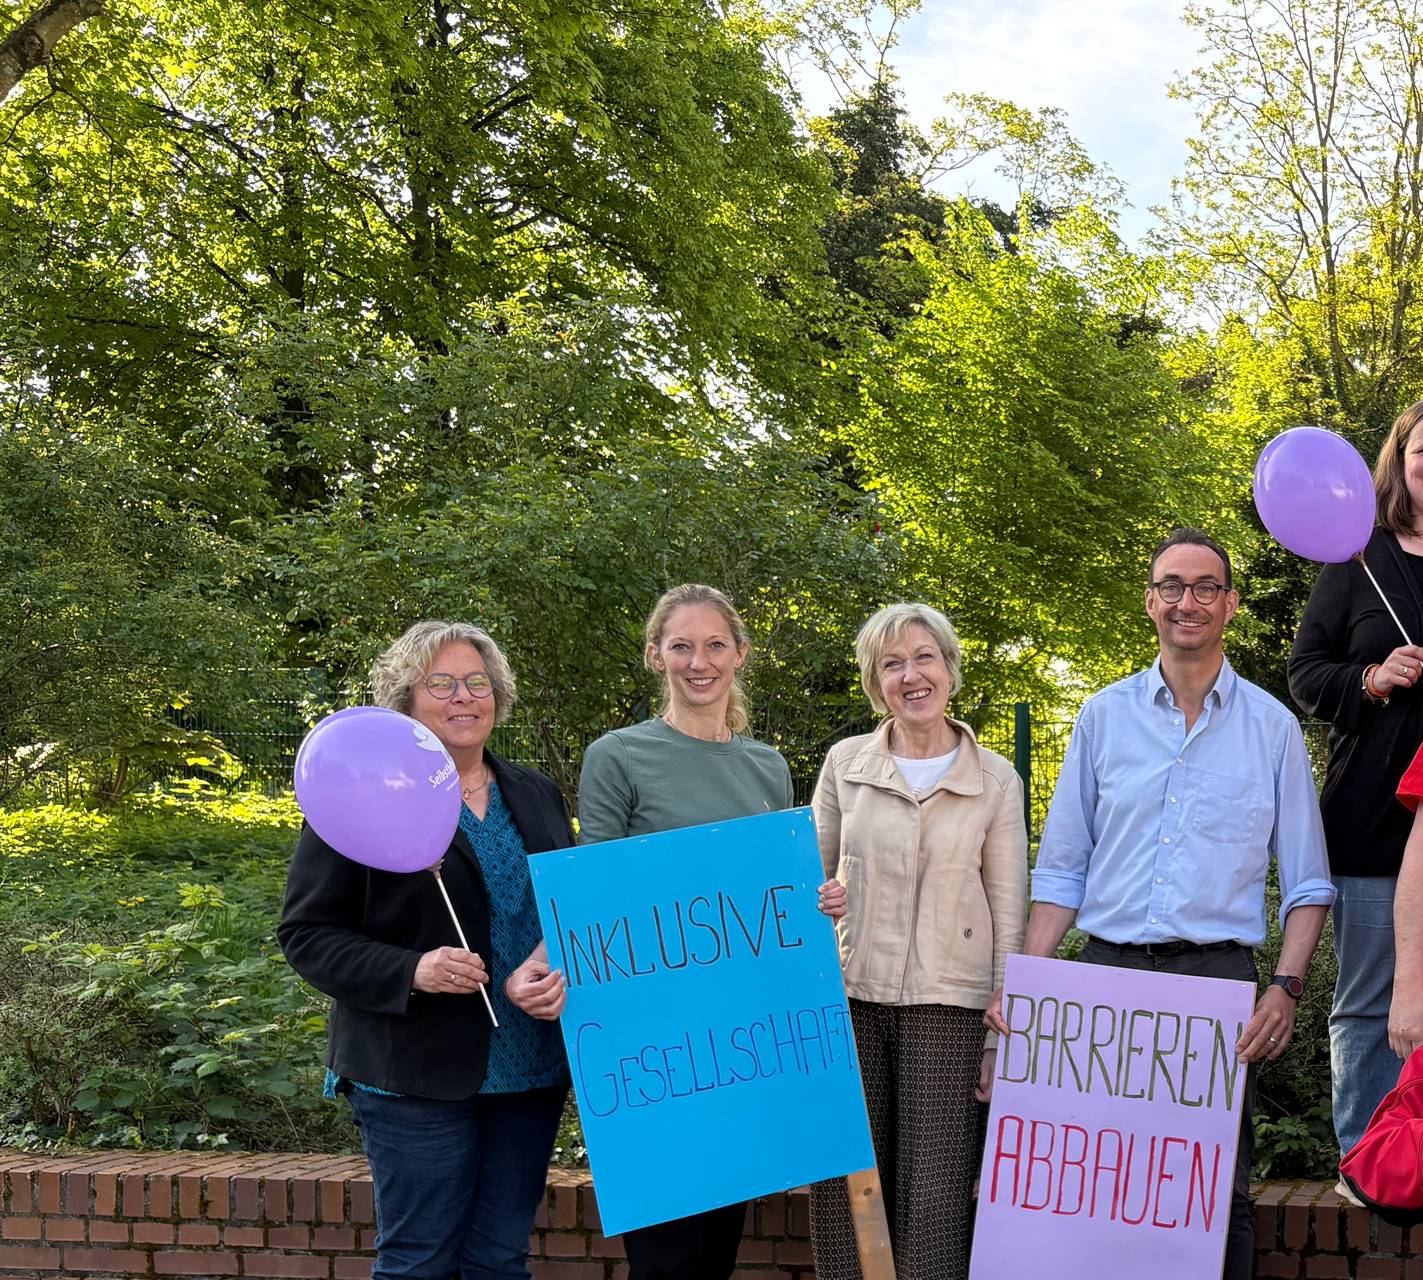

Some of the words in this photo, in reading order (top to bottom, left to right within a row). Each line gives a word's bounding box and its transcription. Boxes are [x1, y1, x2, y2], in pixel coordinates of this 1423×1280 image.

[550, 885, 803, 988] INKLUSIVE
[577, 1004, 854, 1117] GESELLSCHAFT
[997, 993, 1243, 1111] BARRIEREN
[990, 1115, 1221, 1232] ABBAUEN
